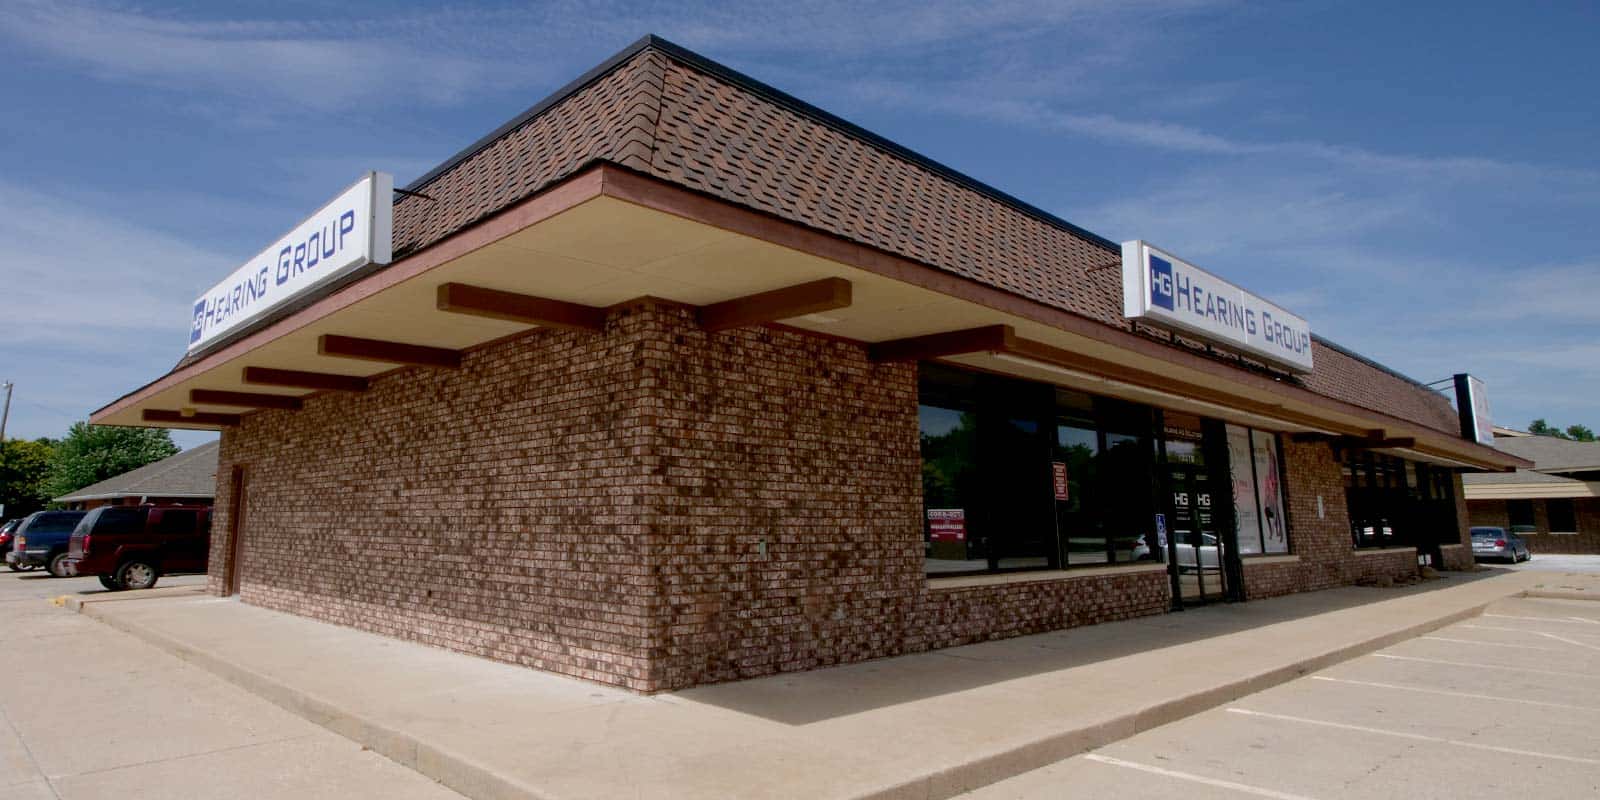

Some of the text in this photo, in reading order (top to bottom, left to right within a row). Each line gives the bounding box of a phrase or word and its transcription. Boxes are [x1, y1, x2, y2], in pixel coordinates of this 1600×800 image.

[203, 266, 268, 331] HEARING
[276, 210, 355, 286] GROUP
[1152, 269, 1310, 354] HG HEARING GROUP
[1174, 492, 1189, 506] HG
[1197, 493, 1211, 506] HG
